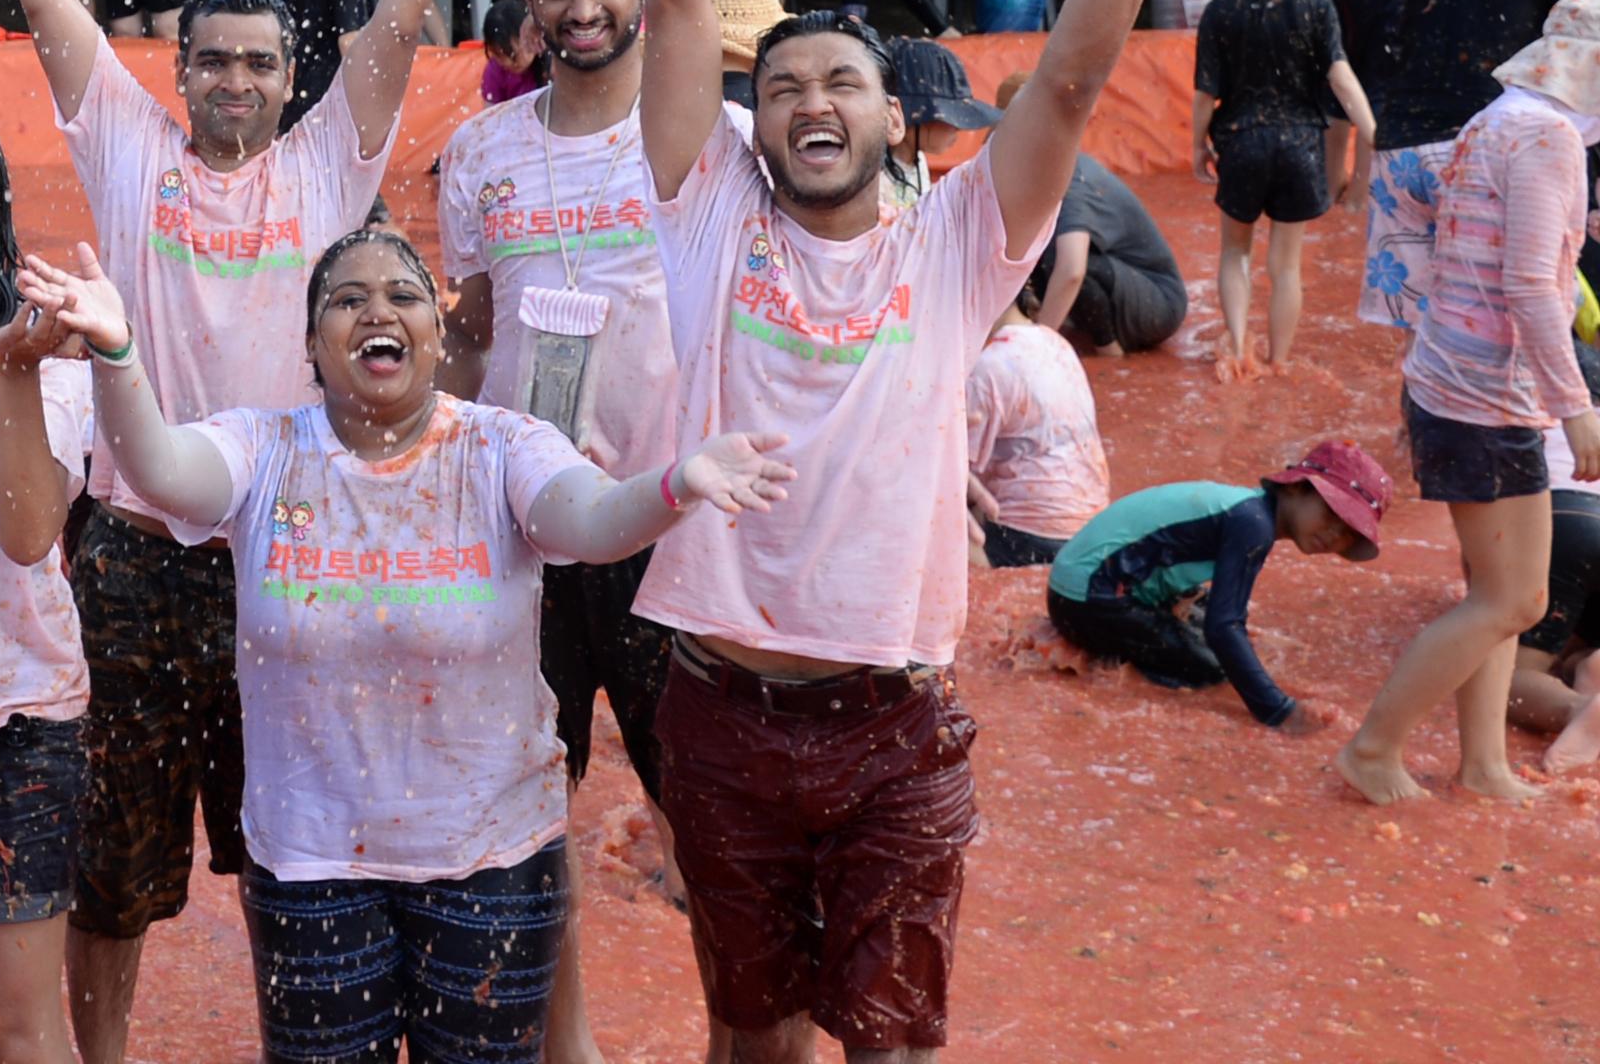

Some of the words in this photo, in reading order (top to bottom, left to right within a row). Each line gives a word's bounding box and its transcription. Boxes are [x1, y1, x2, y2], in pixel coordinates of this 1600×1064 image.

[483, 197, 652, 243] 화천토마토축
[266, 539, 492, 583] 화천토마토축제
[370, 583, 498, 605] FESTIVAL
